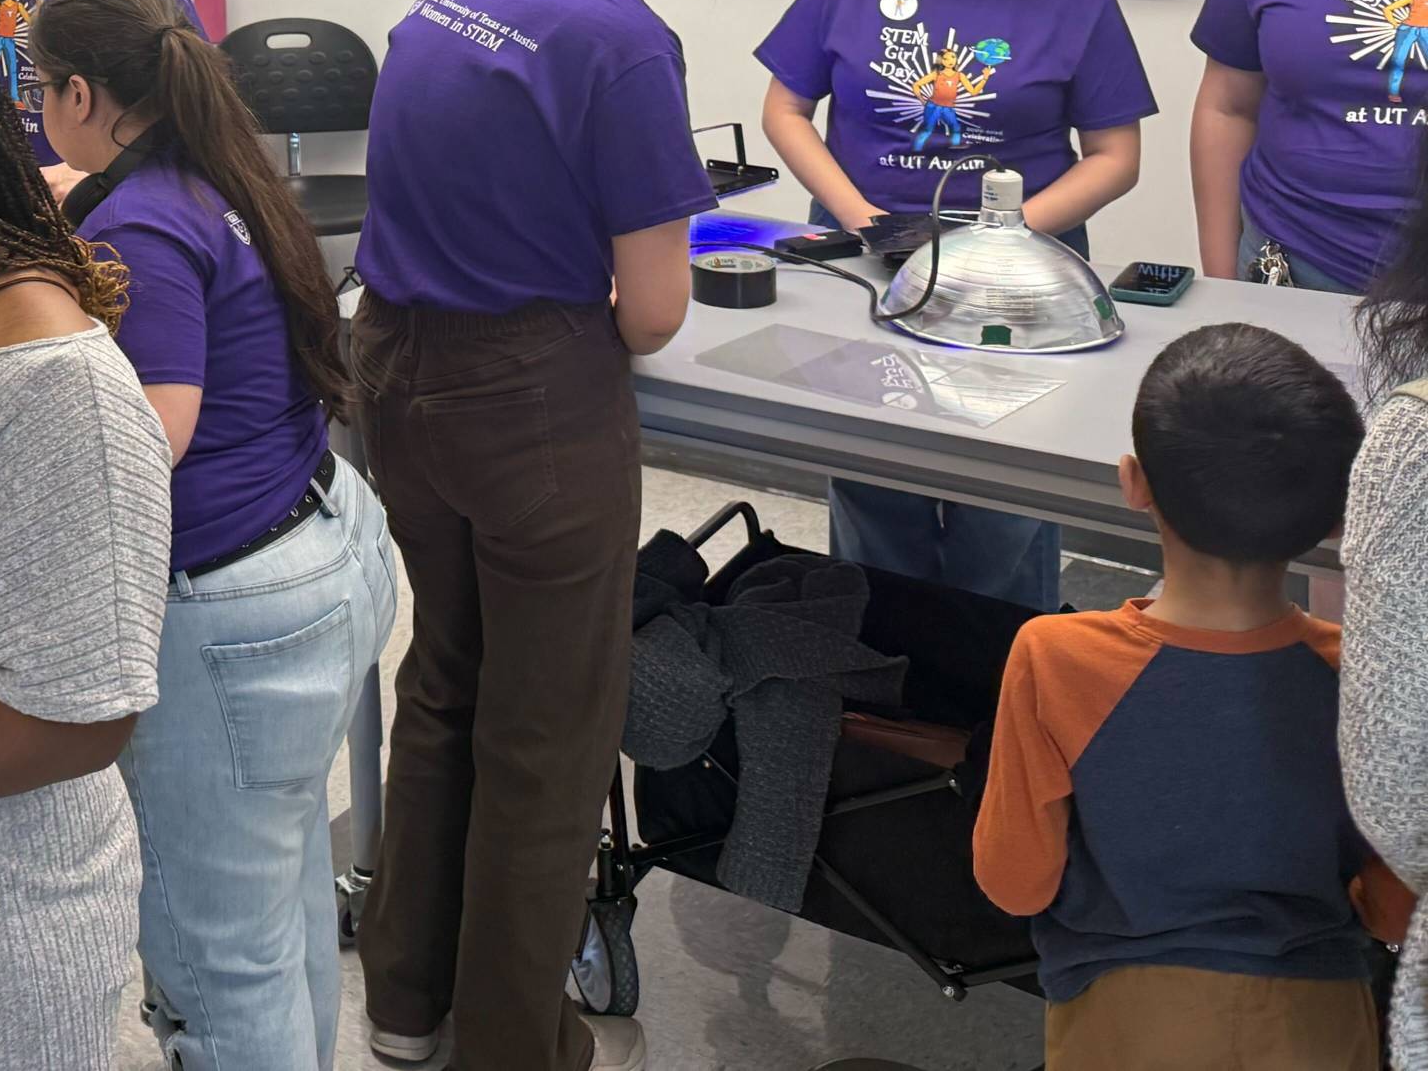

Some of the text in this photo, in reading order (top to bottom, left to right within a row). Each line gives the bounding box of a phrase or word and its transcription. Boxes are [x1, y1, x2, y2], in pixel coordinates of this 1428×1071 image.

[420, 3, 505, 52] Women in STEM
[470, 11, 482, 20] of
[479, 12, 501, 30] Texas
[499, 24, 511, 35] at
[508, 29, 539, 52] Austin
[880, 27, 929, 46] STEM
[884, 45, 919, 61] Girl
[881, 61, 914, 82] Day
[1345, 107, 1428, 125] at UT A
[879, 154, 896, 167] at
[899, 155, 925, 170] UT
